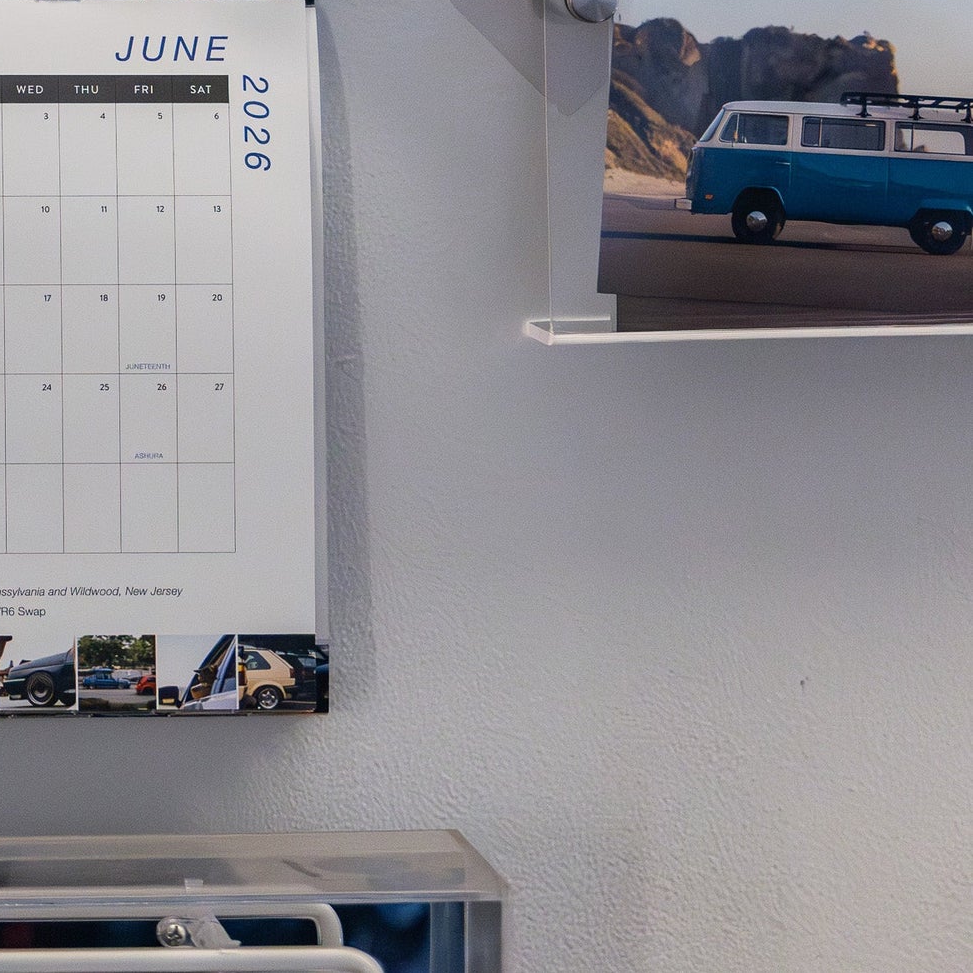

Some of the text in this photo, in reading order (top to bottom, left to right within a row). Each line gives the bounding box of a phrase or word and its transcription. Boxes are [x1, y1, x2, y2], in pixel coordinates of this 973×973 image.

[115, 36, 228, 62] JUNE
[16, 85, 44, 94] WED
[73, 85, 99, 94] THU
[134, 85, 153, 94] FRI
[190, 85, 212, 94] SAT
[242, 74, 271, 171] 2026
[41, 205, 50, 213] 10
[101, 205, 107, 213] 11
[156, 205, 165, 213] 12
[213, 205, 222, 213] 13
[43, 294, 52, 302] 17
[99, 293, 109, 302] 18
[157, 293, 166, 302] 19
[211, 293, 223, 302] 20
[42, 383, 52, 391] 24
[99, 383, 110, 391] 25
[157, 383, 167, 391] 26
[215, 383, 225, 391] 27
[47, 587, 68, 597] and
[70, 586, 121, 597] Wildwood,
[125, 586, 148, 596] New
[150, 586, 183, 598] Jersey
[17, 606, 46, 618] Swap
